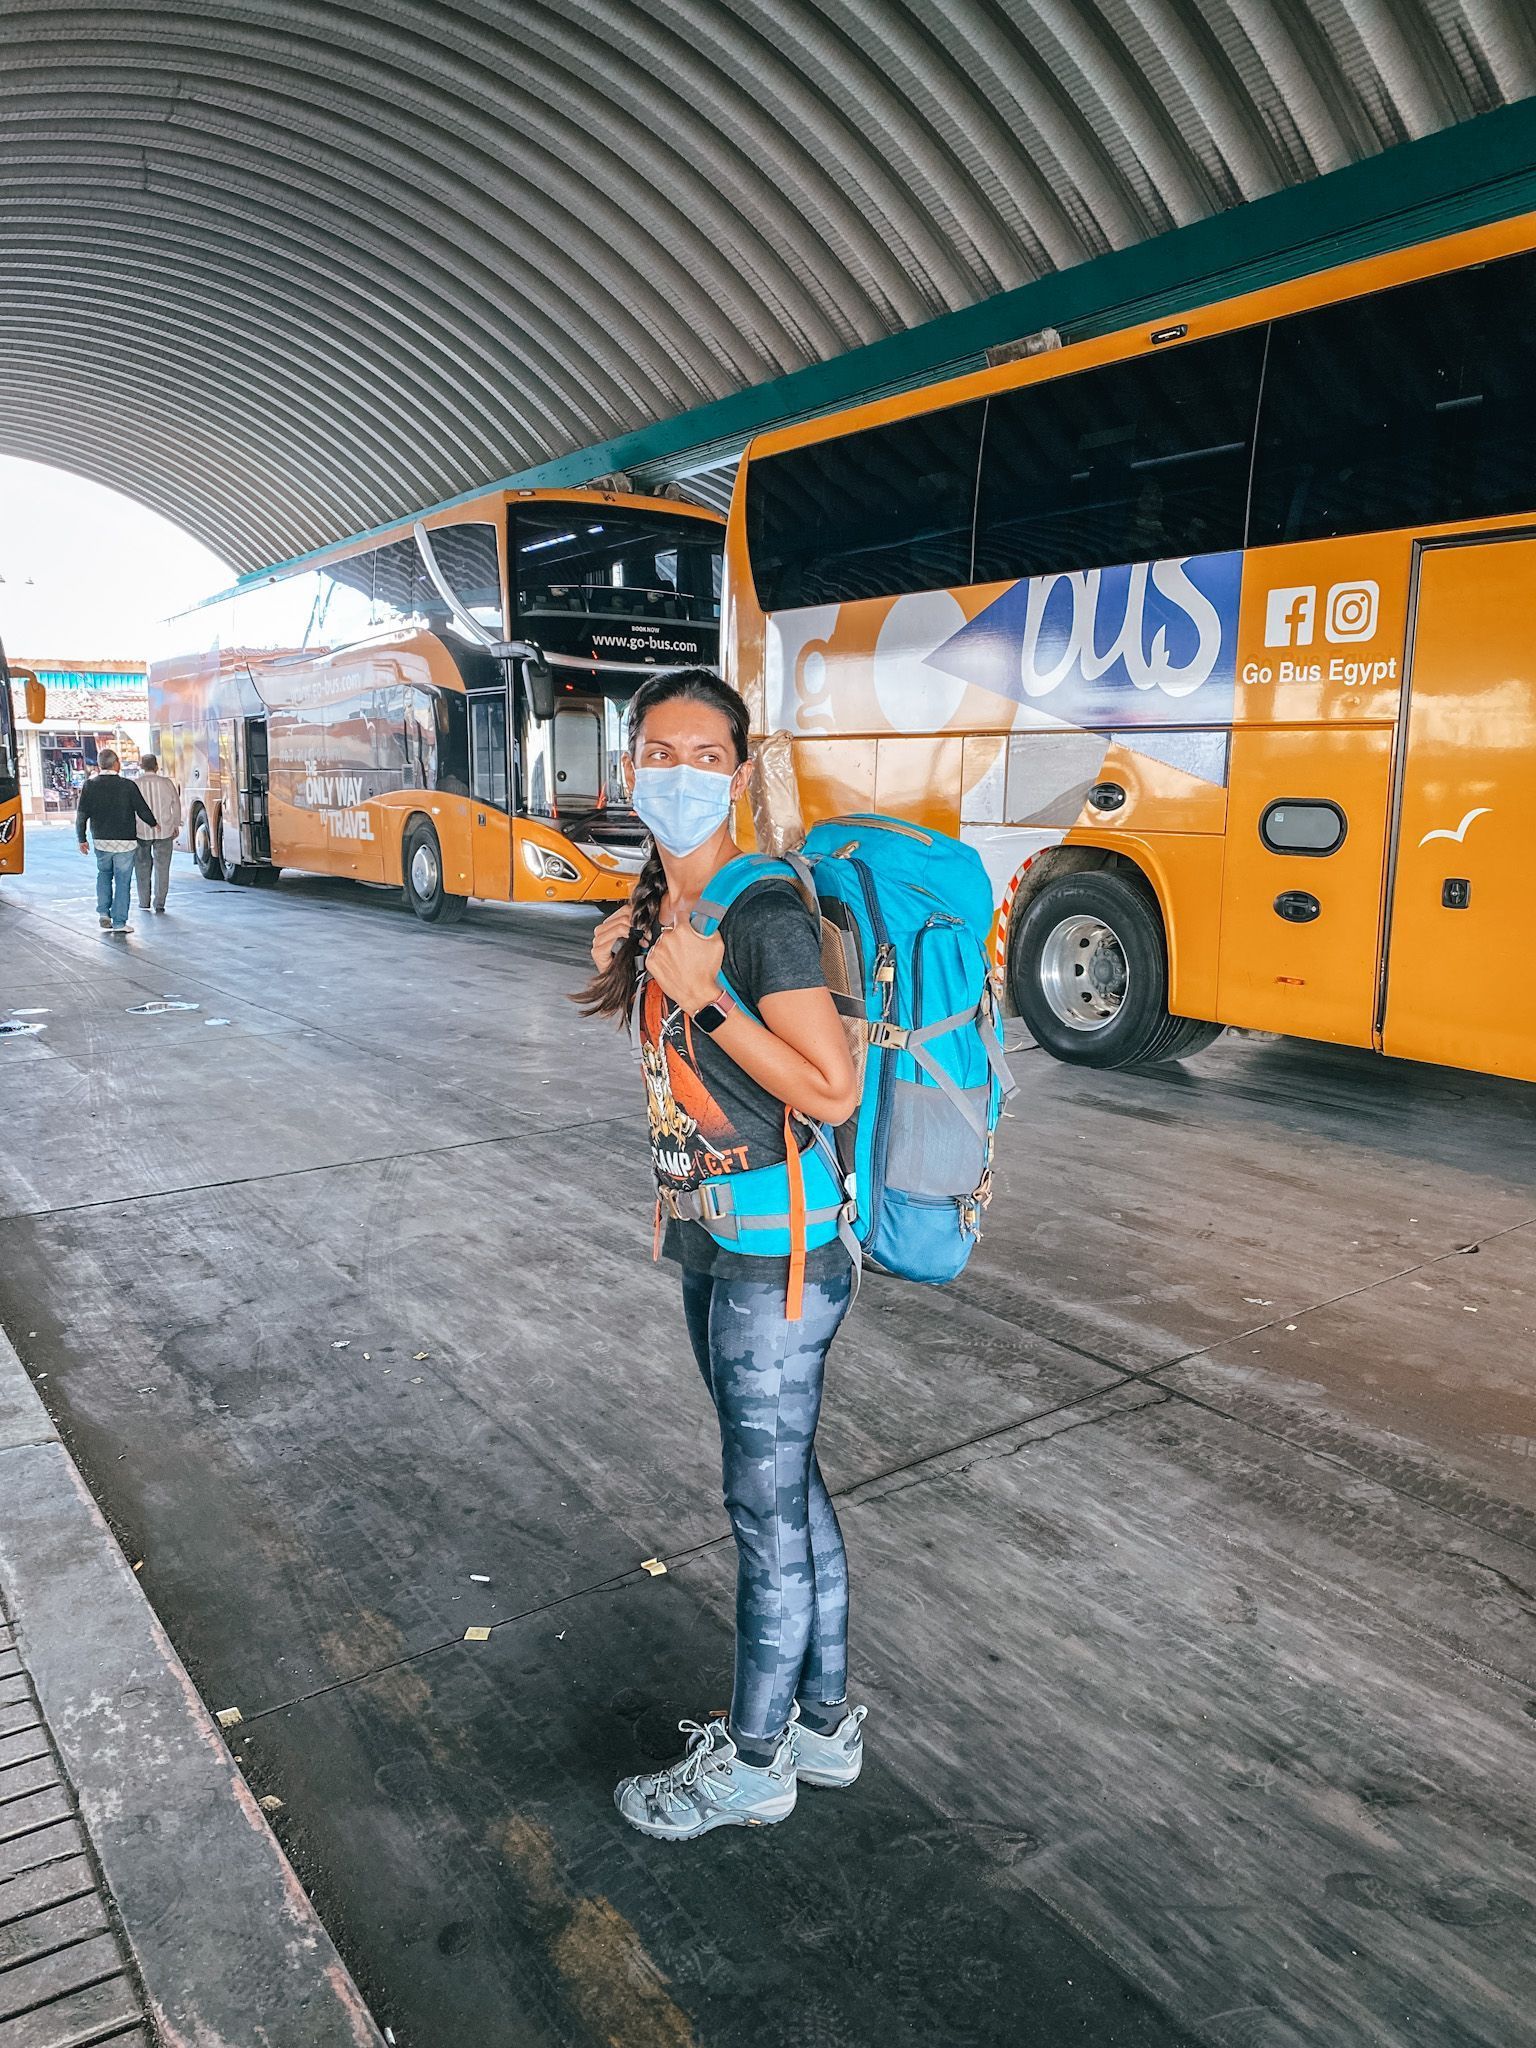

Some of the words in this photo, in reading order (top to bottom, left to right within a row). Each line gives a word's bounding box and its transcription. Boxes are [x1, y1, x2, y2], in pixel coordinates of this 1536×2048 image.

[592, 635, 697, 652] www.go-bus.com
[1242, 663, 1272, 684] Go
[1279, 661, 1321, 683] Bus
[1328, 657, 1397, 686] Egypt
[304, 760, 317, 777] THE
[305, 777, 333, 806] ONLY
[335, 777, 363, 807] WAY
[328, 809, 374, 841] TRAVEL
